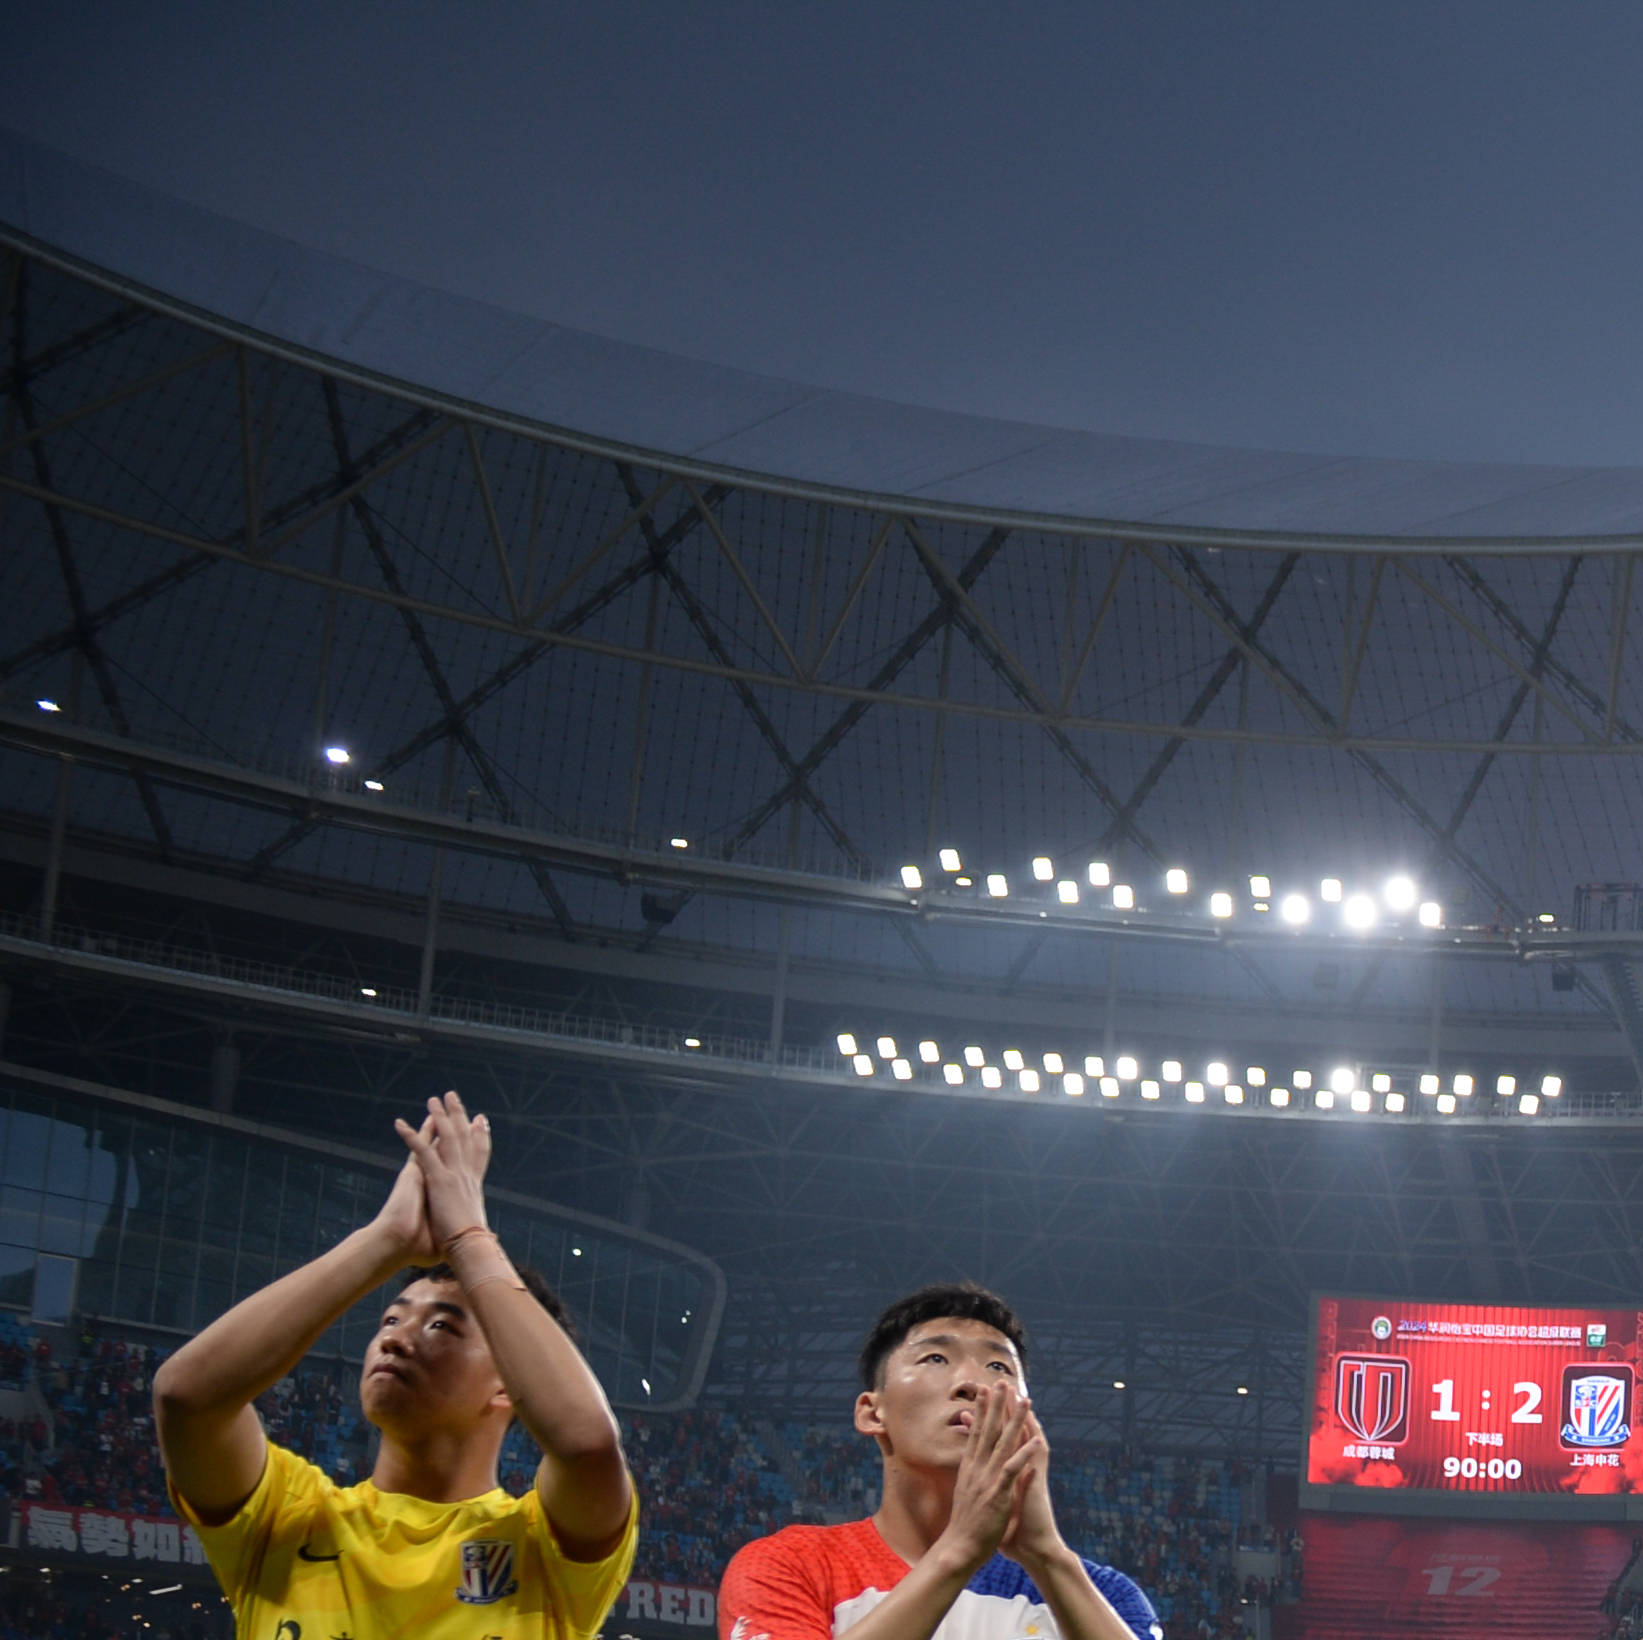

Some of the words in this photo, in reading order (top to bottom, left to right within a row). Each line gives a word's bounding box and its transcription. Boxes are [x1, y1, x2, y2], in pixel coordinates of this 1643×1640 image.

[1431, 1379, 1461, 1421] 1
[1511, 1381, 1543, 1424] 2
[1465, 1432, 1504, 1448] 下半场
[1342, 1445, 1395, 1461] 成都蓉城
[1569, 1453, 1620, 1467] 上海申花
[1443, 1456, 1522, 1480] 90:00
[1422, 1566, 1501, 1597] 12
[626, 1582, 716, 1627] RED
